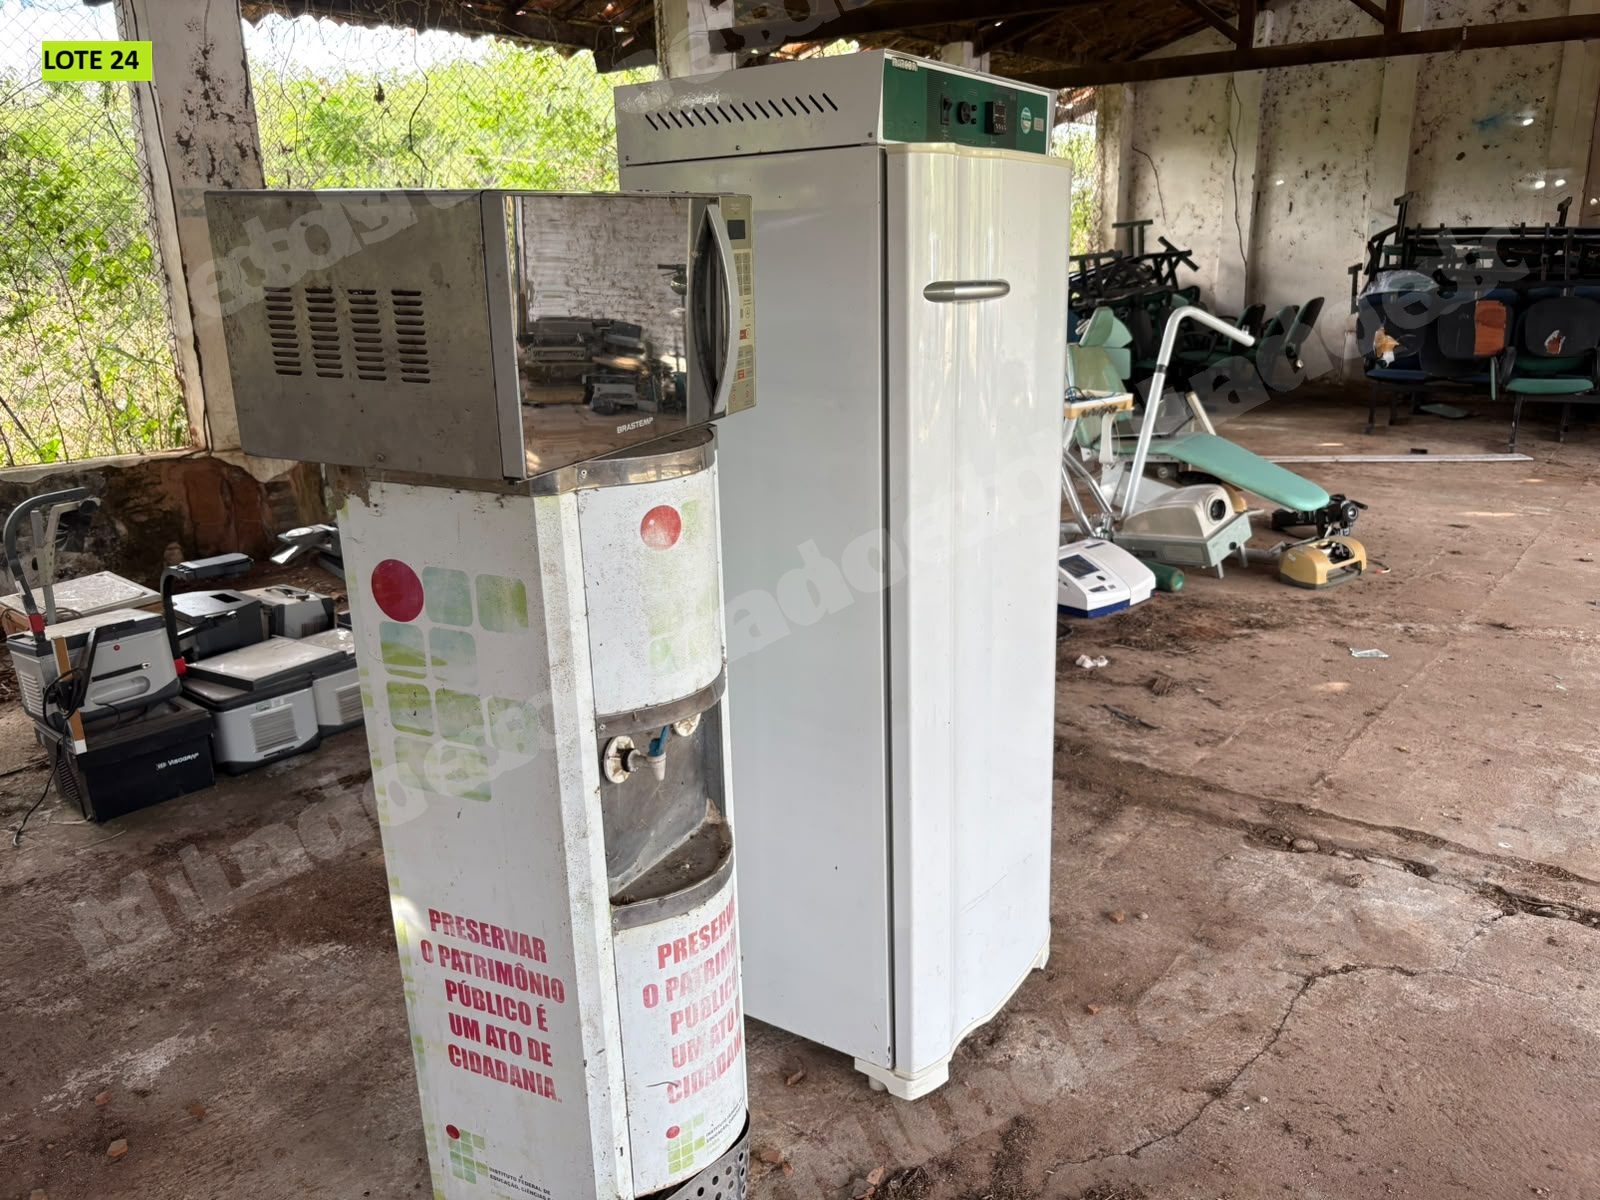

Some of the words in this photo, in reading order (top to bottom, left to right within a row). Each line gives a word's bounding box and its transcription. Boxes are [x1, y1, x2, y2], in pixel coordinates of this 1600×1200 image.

[428, 908, 548, 964] PRESERVAR
[420, 939, 435, 964] O
[437, 943, 566, 1004] PATRIMÔNIO
[642, 983, 660, 1009] O
[444, 978, 532, 1027] PÚBLICO
[536, 1003, 549, 1033] É
[448, 1011, 481, 1043] UM
[485, 1023, 523, 1056] ATO
[527, 1036, 554, 1067] DE
